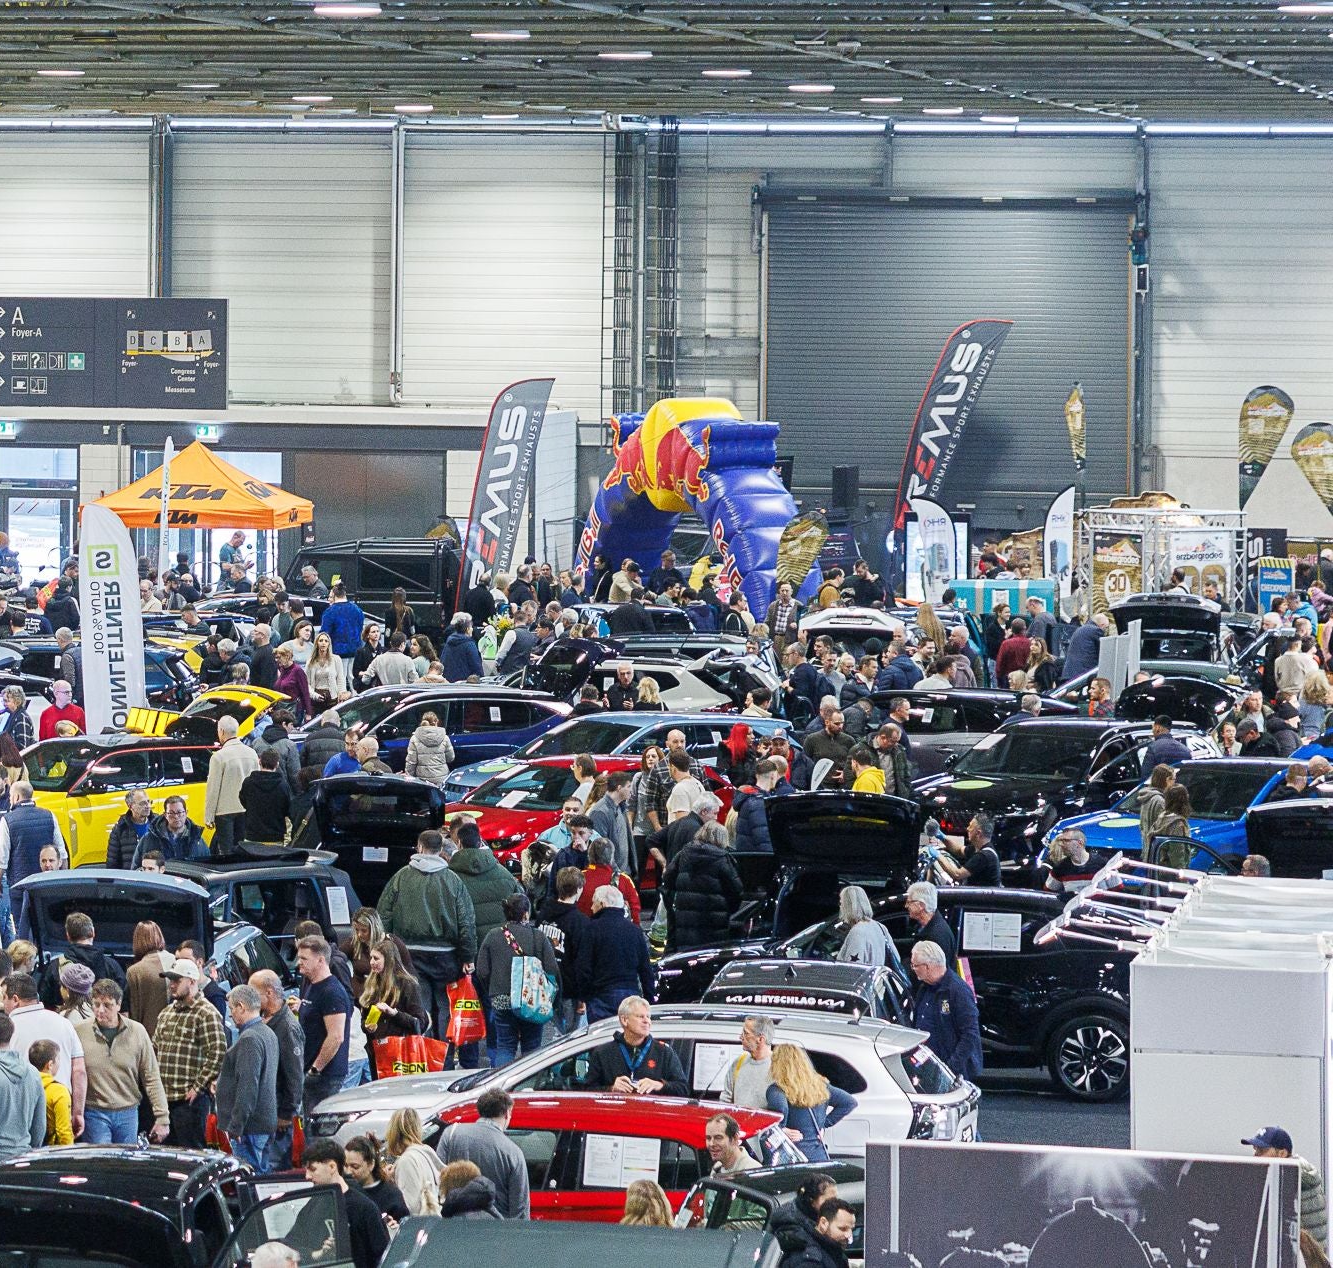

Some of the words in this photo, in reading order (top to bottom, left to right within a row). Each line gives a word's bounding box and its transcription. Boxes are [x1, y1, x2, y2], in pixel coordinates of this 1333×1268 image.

[12, 307, 24, 325] A
[12, 327, 43, 338] Foyer-A
[130, 336, 136, 345] D
[150, 336, 156, 345] C
[175, 336, 181, 345] B
[199, 335, 205, 344] A
[13, 354, 28, 362] EXIT
[122, 360, 139, 368] Foyer-
[170, 368, 196, 377] Congress
[906, 342, 983, 501] REMUS
[929, 443, 957, 498] FORMANCE
[952, 406, 971, 439] SPORT
[967, 349, 995, 403] EXHAUSTS
[139, 484, 228, 501] KTM
[243, 480, 278, 500] KTM
[498, 518, 517, 575] ORMANCE
[511, 476, 527, 519] SPORT
[520, 410, 541, 472] EXHAUSTS
[153, 510, 199, 525] KTM
[288, 508, 299, 523] KTM
[1176, 551, 1224, 561] erzbergrodeo
[1108, 573, 1126, 593] 30
[754, 994, 816, 1007] BEYSCHLAG
[393, 1062, 427, 1075] ZGON
